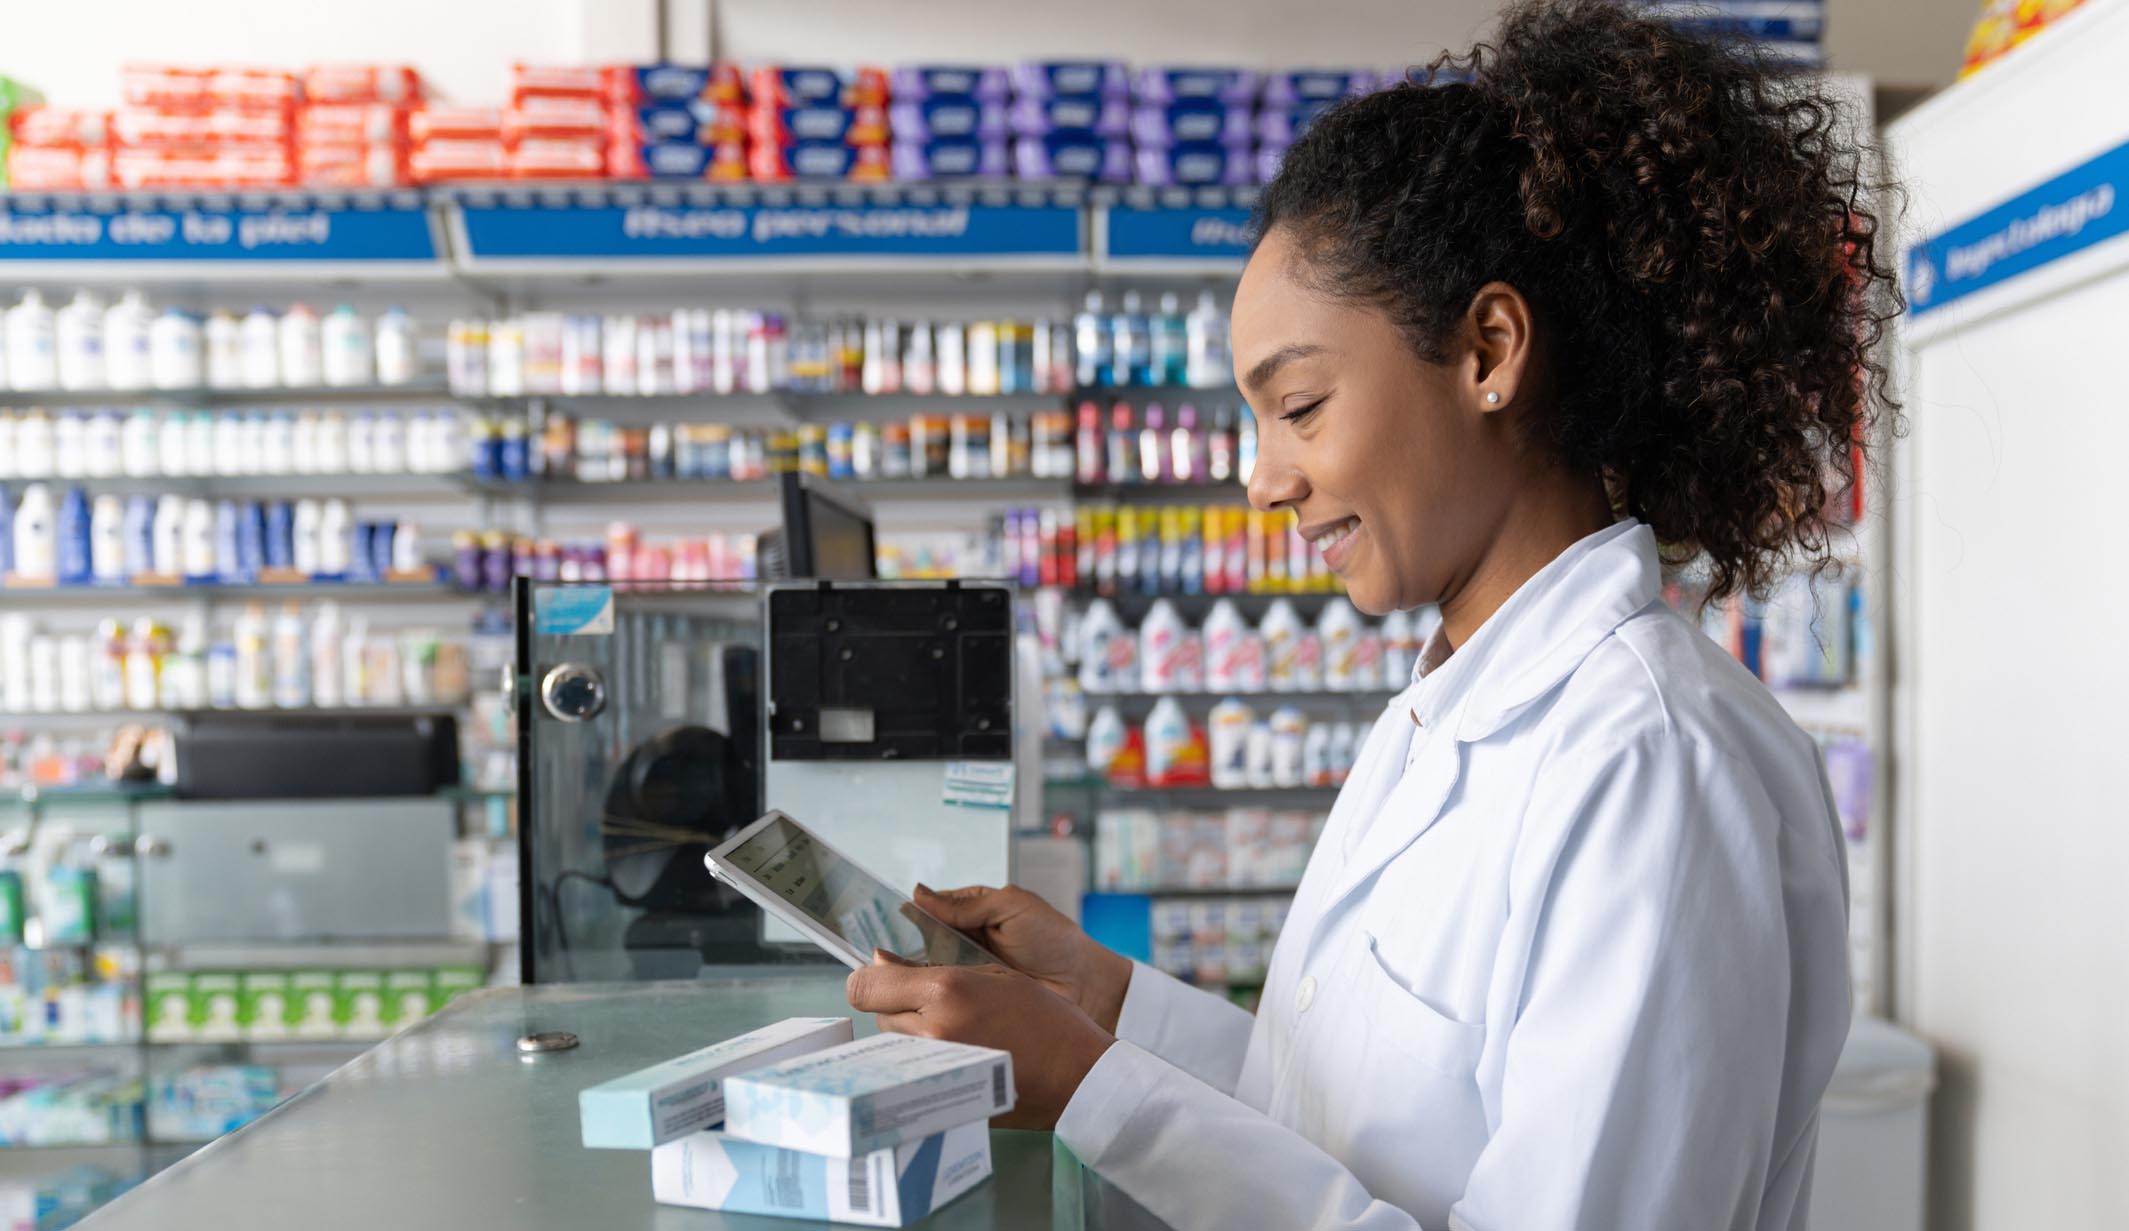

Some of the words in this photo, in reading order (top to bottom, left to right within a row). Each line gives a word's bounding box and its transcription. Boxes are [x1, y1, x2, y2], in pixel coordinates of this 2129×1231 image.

[108, 213, 175, 245] de
[181, 211, 232, 245] la
[238, 211, 331, 250] piel
[752, 206, 970, 243] personal
